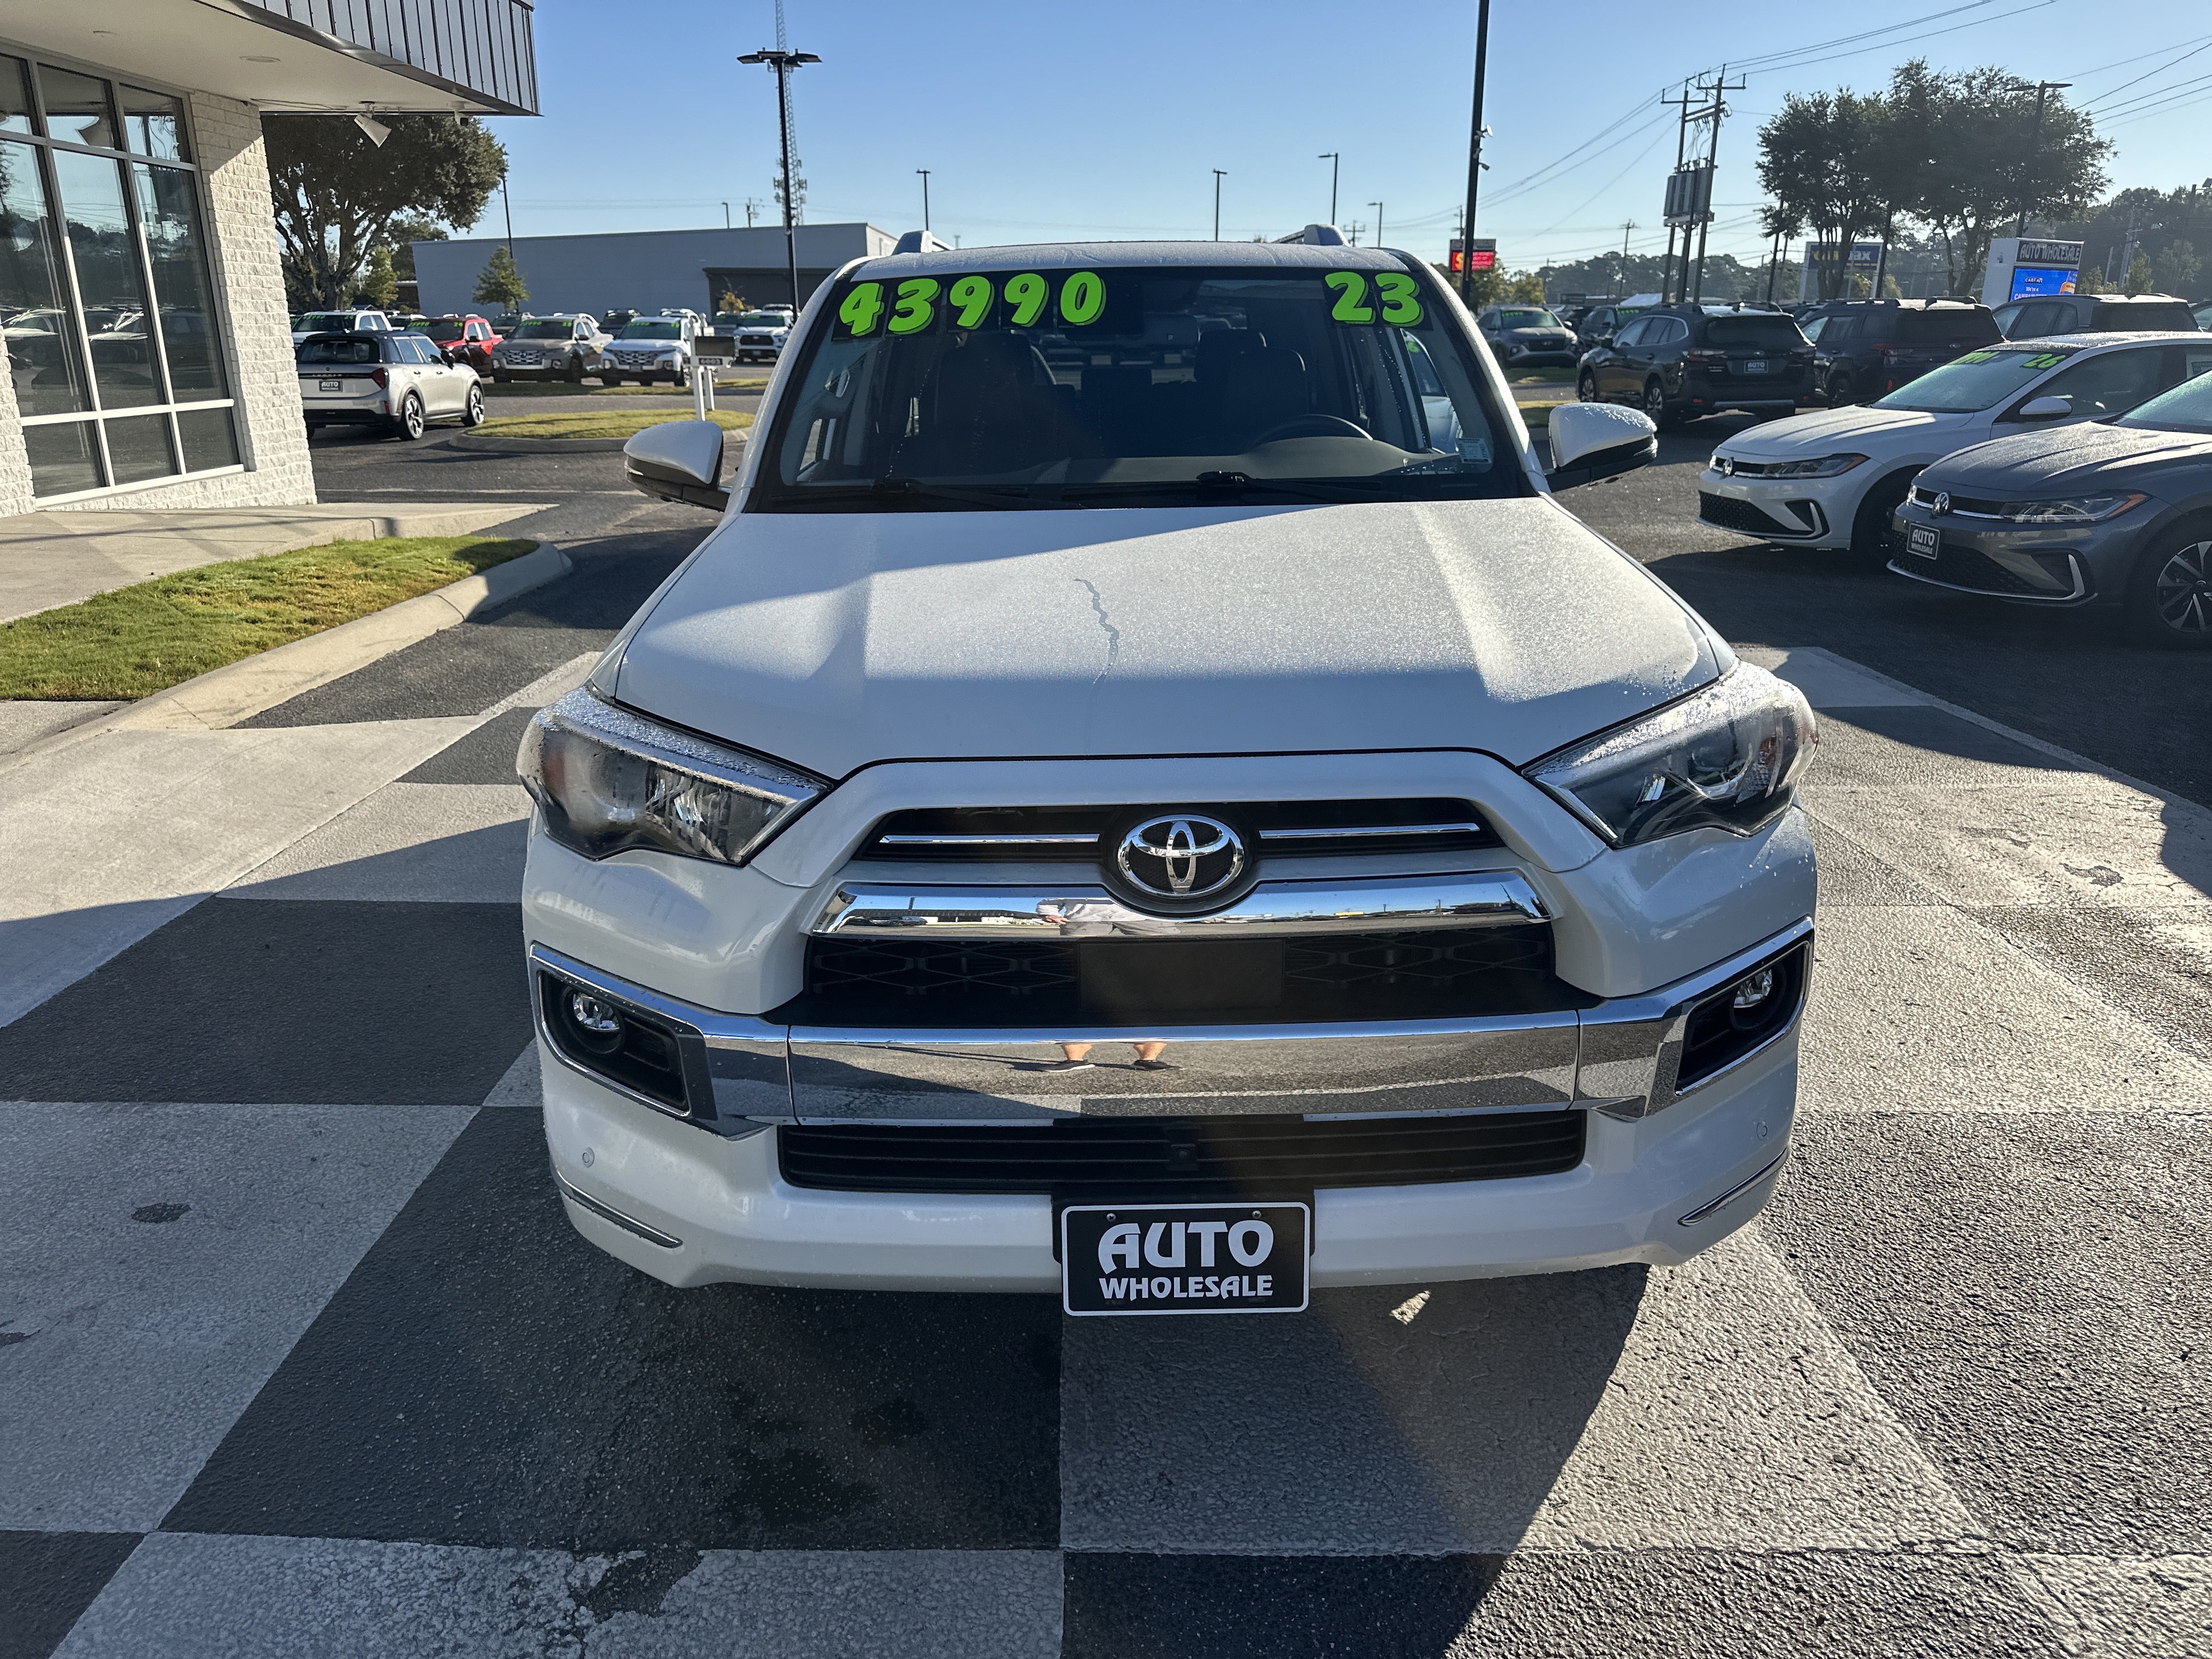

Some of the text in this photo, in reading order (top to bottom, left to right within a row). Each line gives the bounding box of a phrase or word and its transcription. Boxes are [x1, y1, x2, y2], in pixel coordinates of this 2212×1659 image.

[2019, 243, 2080, 261] AUTO WHOLESALE
[839, 272, 1106, 336] 43990
[1324, 272, 1424, 327] 23
[2023, 353, 2066, 369] 26
[1912, 528, 1936, 546] AUTO
[1098, 1220, 1274, 1274] AUTO
[1099, 1275, 1273, 1301] WHOLESALE
